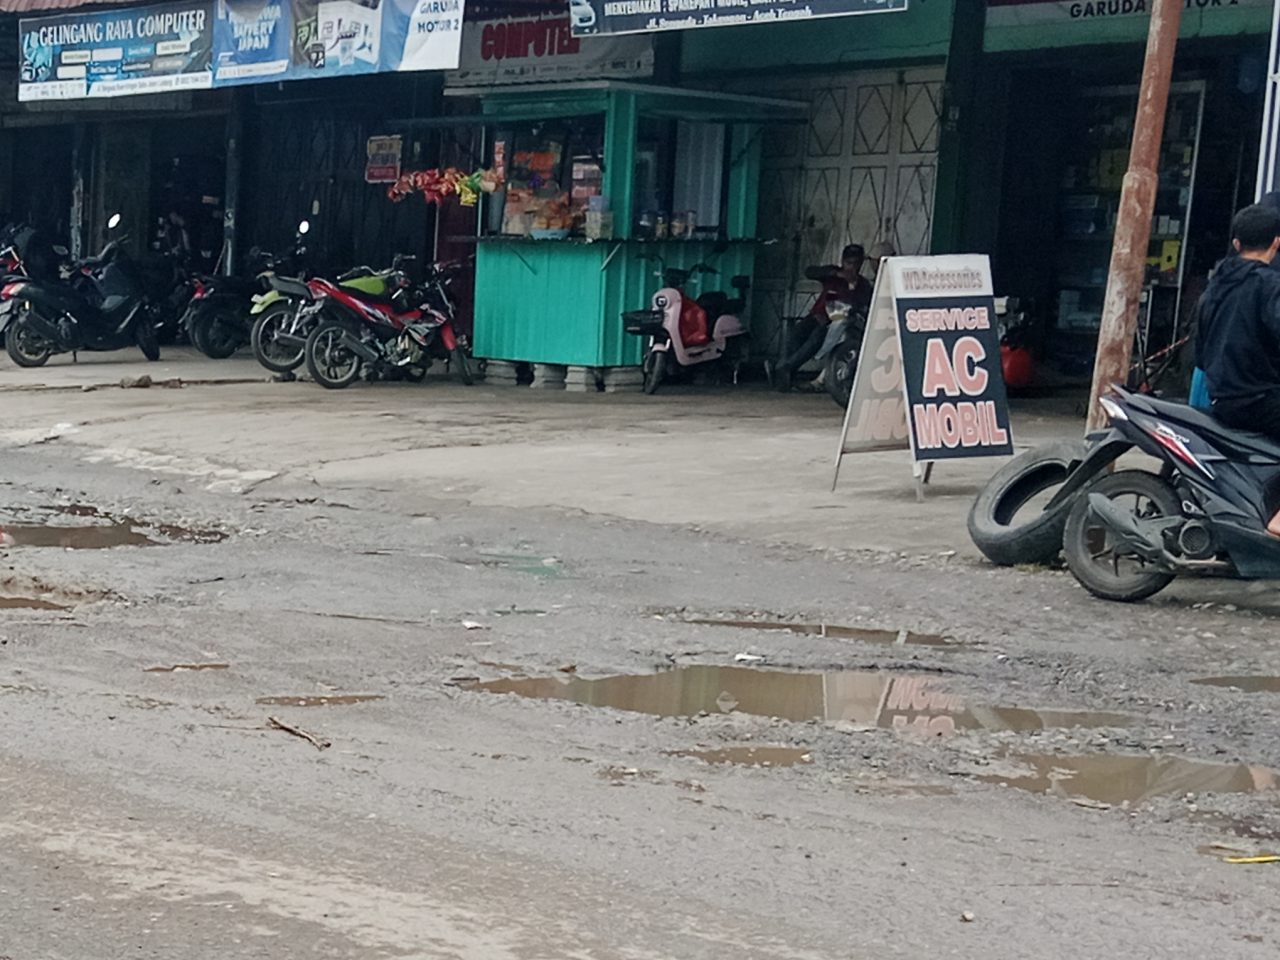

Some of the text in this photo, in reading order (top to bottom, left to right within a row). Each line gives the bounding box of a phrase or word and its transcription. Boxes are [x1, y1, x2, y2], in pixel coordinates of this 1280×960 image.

[1071, 1, 1147, 18] GARUDA
[40, 23, 103, 46] GELINGANG
[106, 17, 134, 41] RAYA
[136, 10, 205, 38] COMPUTER
[906, 306, 990, 332] SERVICE
[922, 336, 989, 398] AC
[913, 401, 1008, 449] MOBIL
